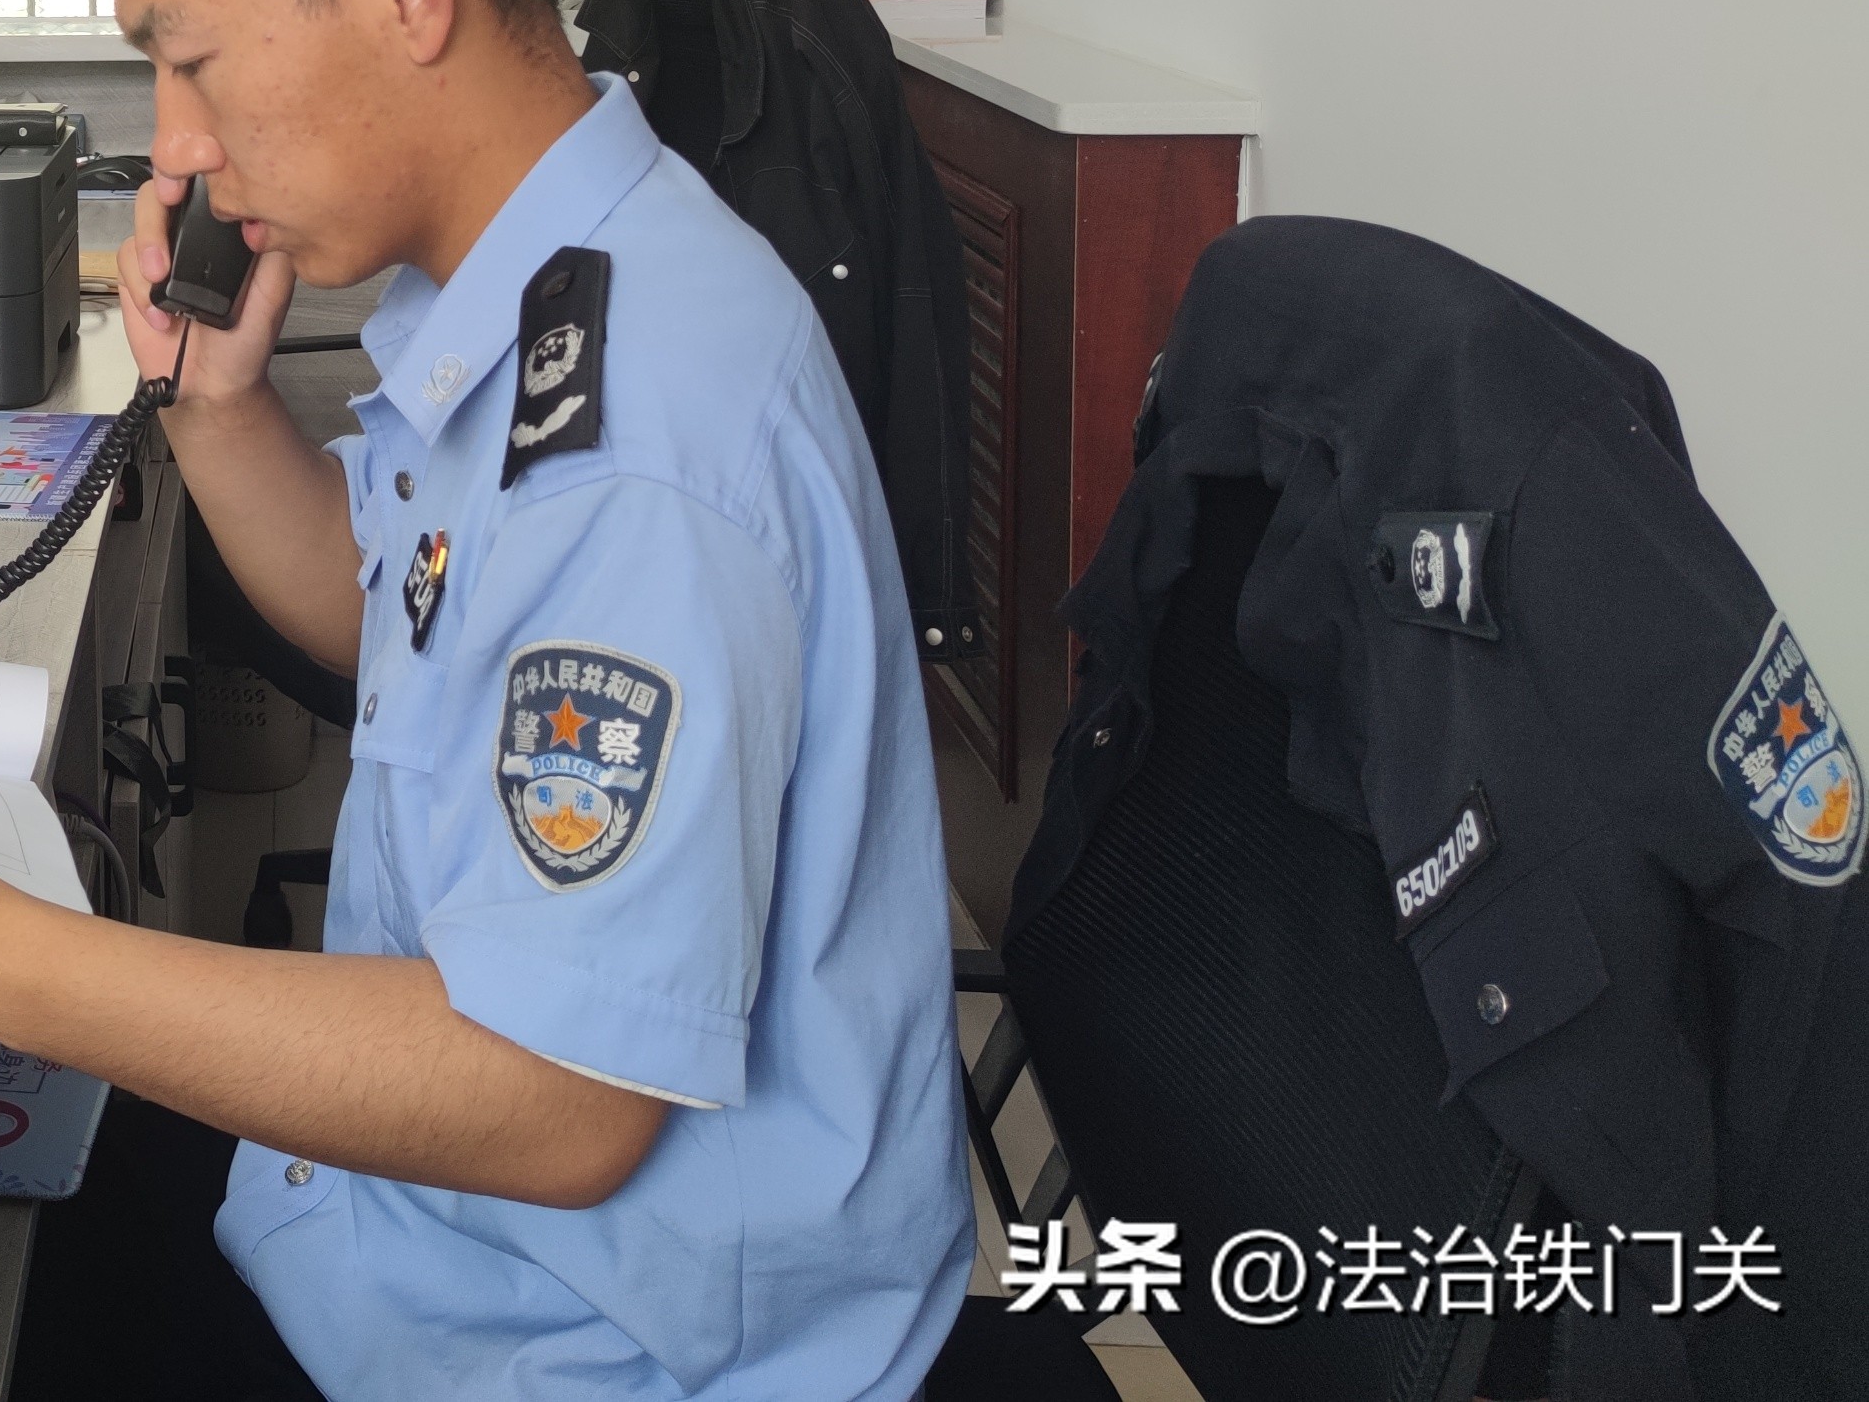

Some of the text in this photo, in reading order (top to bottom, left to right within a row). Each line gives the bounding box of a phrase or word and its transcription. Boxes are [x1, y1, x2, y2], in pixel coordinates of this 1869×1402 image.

[512, 658, 658, 718] 中华人民共和国
[512, 709, 642, 766] 警 察
[531, 754, 603, 782] POLICE
[1739, 741, 1777, 794] 警
